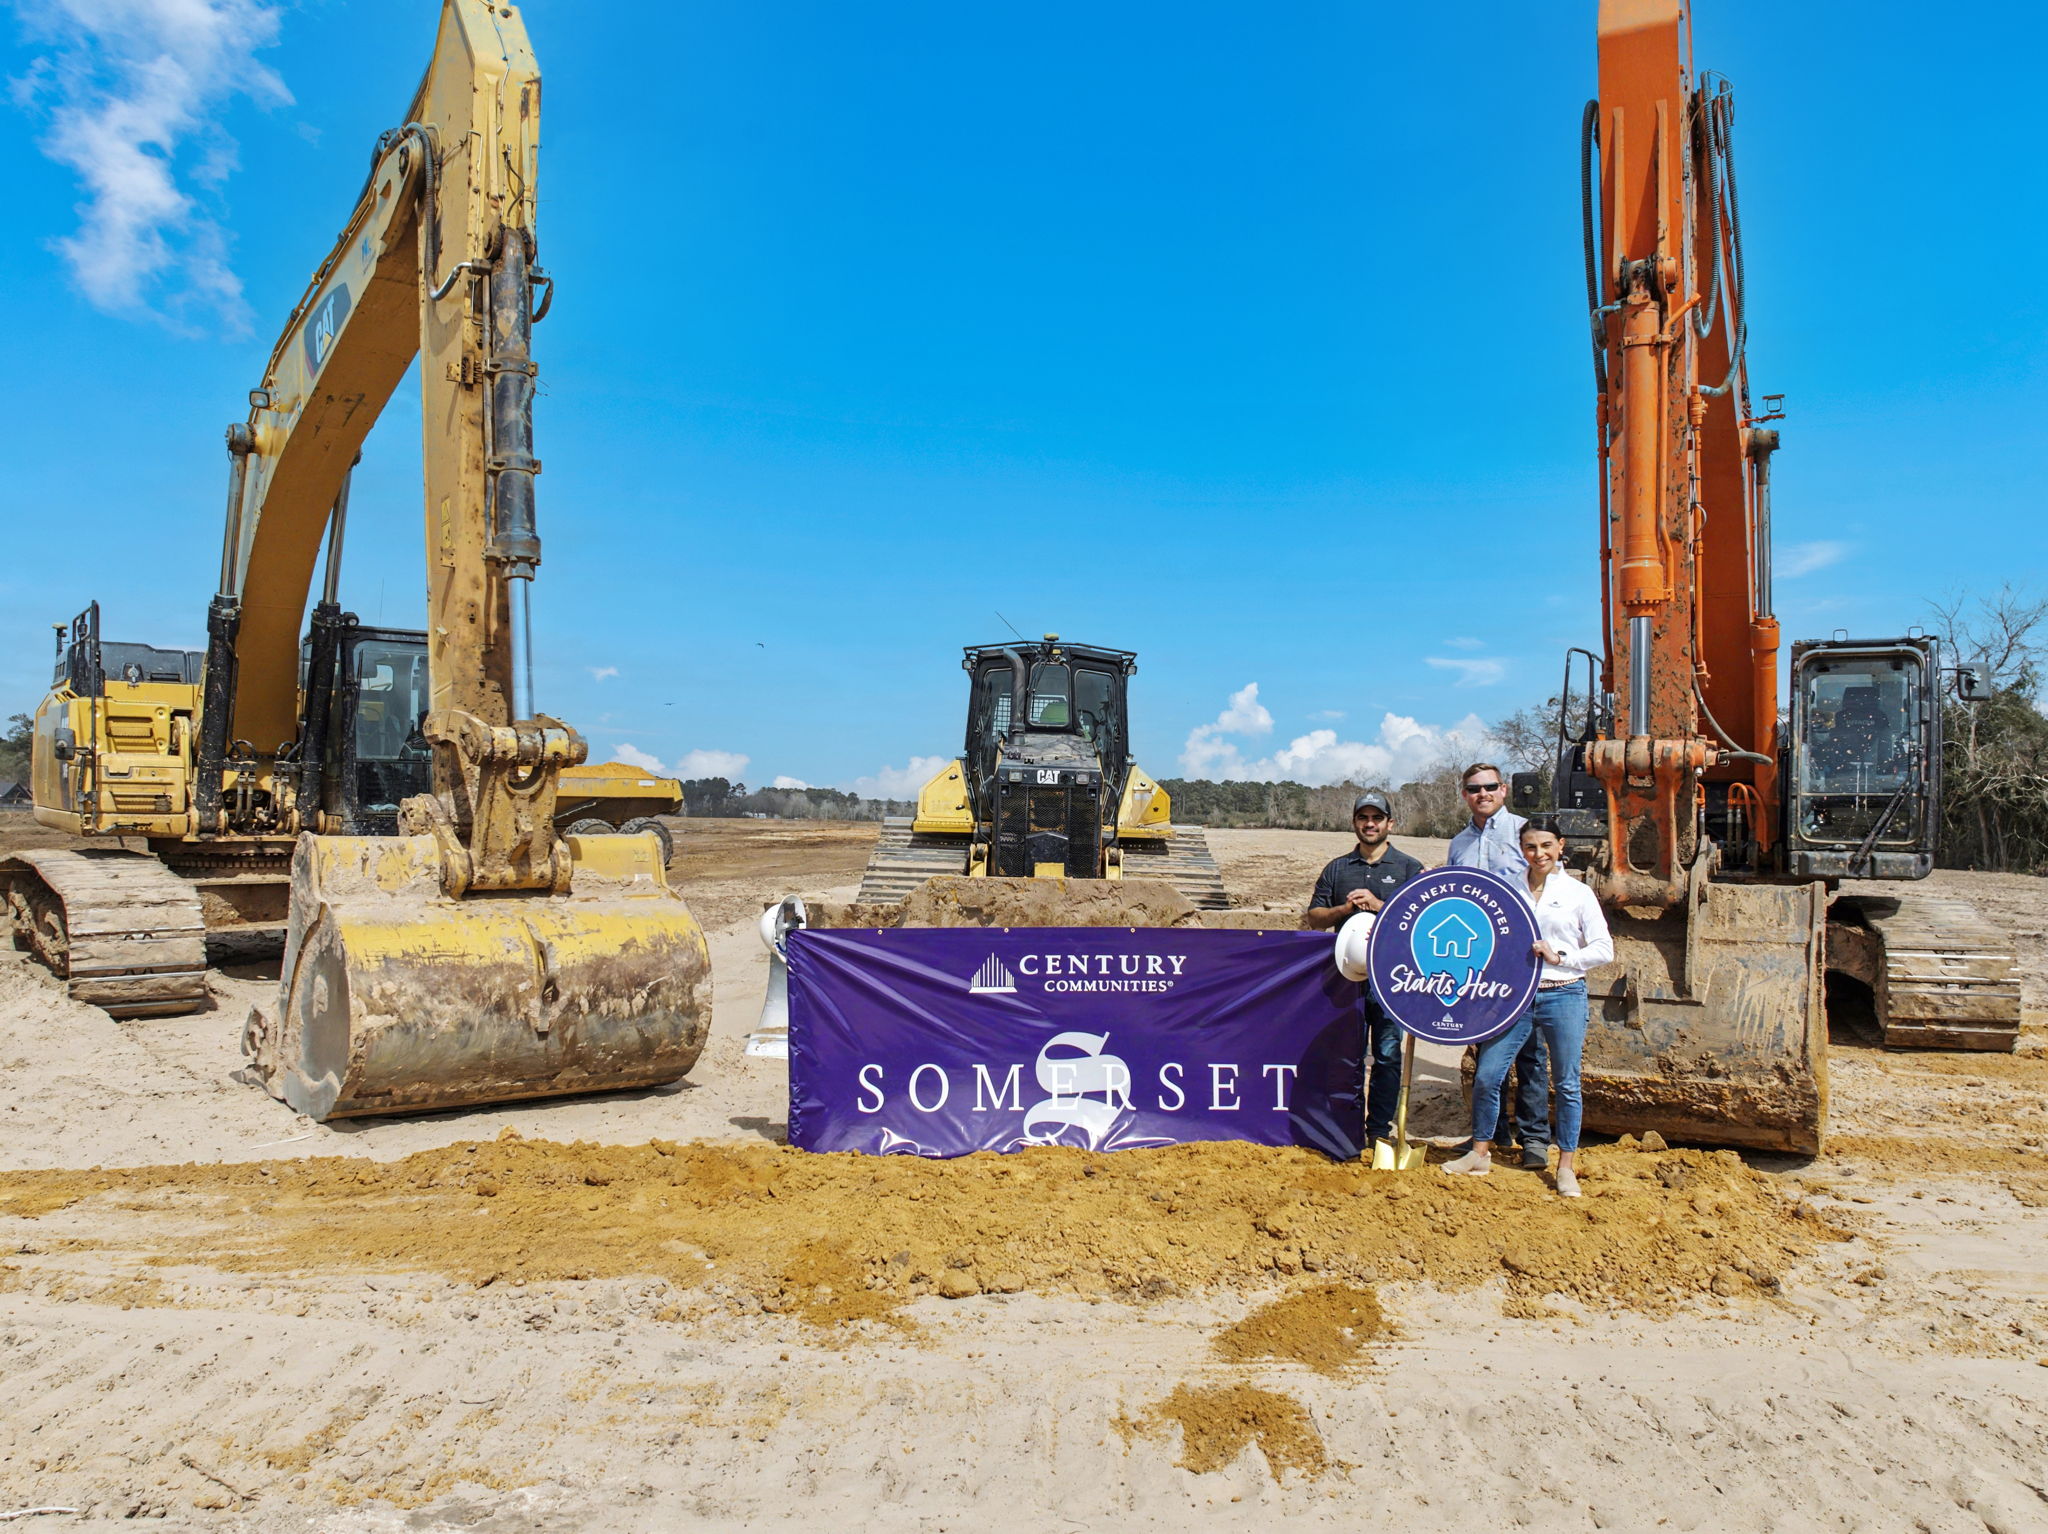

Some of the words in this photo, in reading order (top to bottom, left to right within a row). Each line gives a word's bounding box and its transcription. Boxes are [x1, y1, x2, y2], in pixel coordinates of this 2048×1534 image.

[316, 294, 335, 364] CAT
[1037, 769, 1060, 785] CAT
[1399, 903, 1419, 931] OUR
[1420, 883, 1456, 902] NEXT
[1462, 884, 1510, 935] CHAPTER
[1019, 954, 1187, 975] CENTURY
[1390, 963, 1455, 995] Starts
[1456, 967, 1512, 1001] Here
[857, 1063, 1298, 1113] SOMERSET
